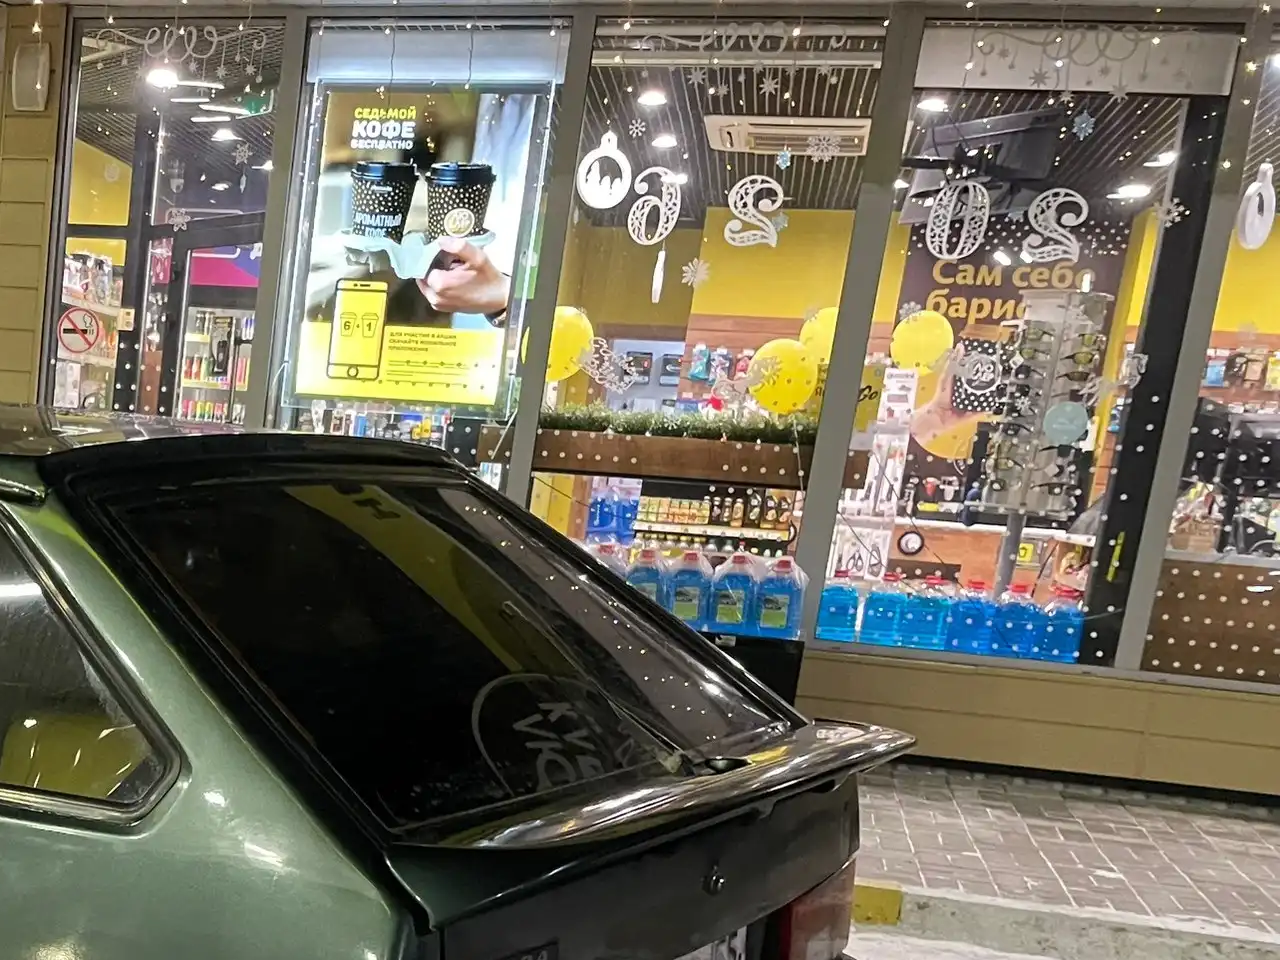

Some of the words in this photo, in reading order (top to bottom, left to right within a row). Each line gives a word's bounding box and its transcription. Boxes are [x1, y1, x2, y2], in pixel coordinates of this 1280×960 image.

[354, 106, 417, 120] СЕДЬМОЙ
[352, 120, 416, 139] КОФЕ
[351, 138, 414, 150] БЕСПЛАТНО
[932, 259, 1002, 287] Сам
[925, 288, 1027, 325] барис
[343, 320, 351, 331] 6
[365, 321, 372, 332] 1
